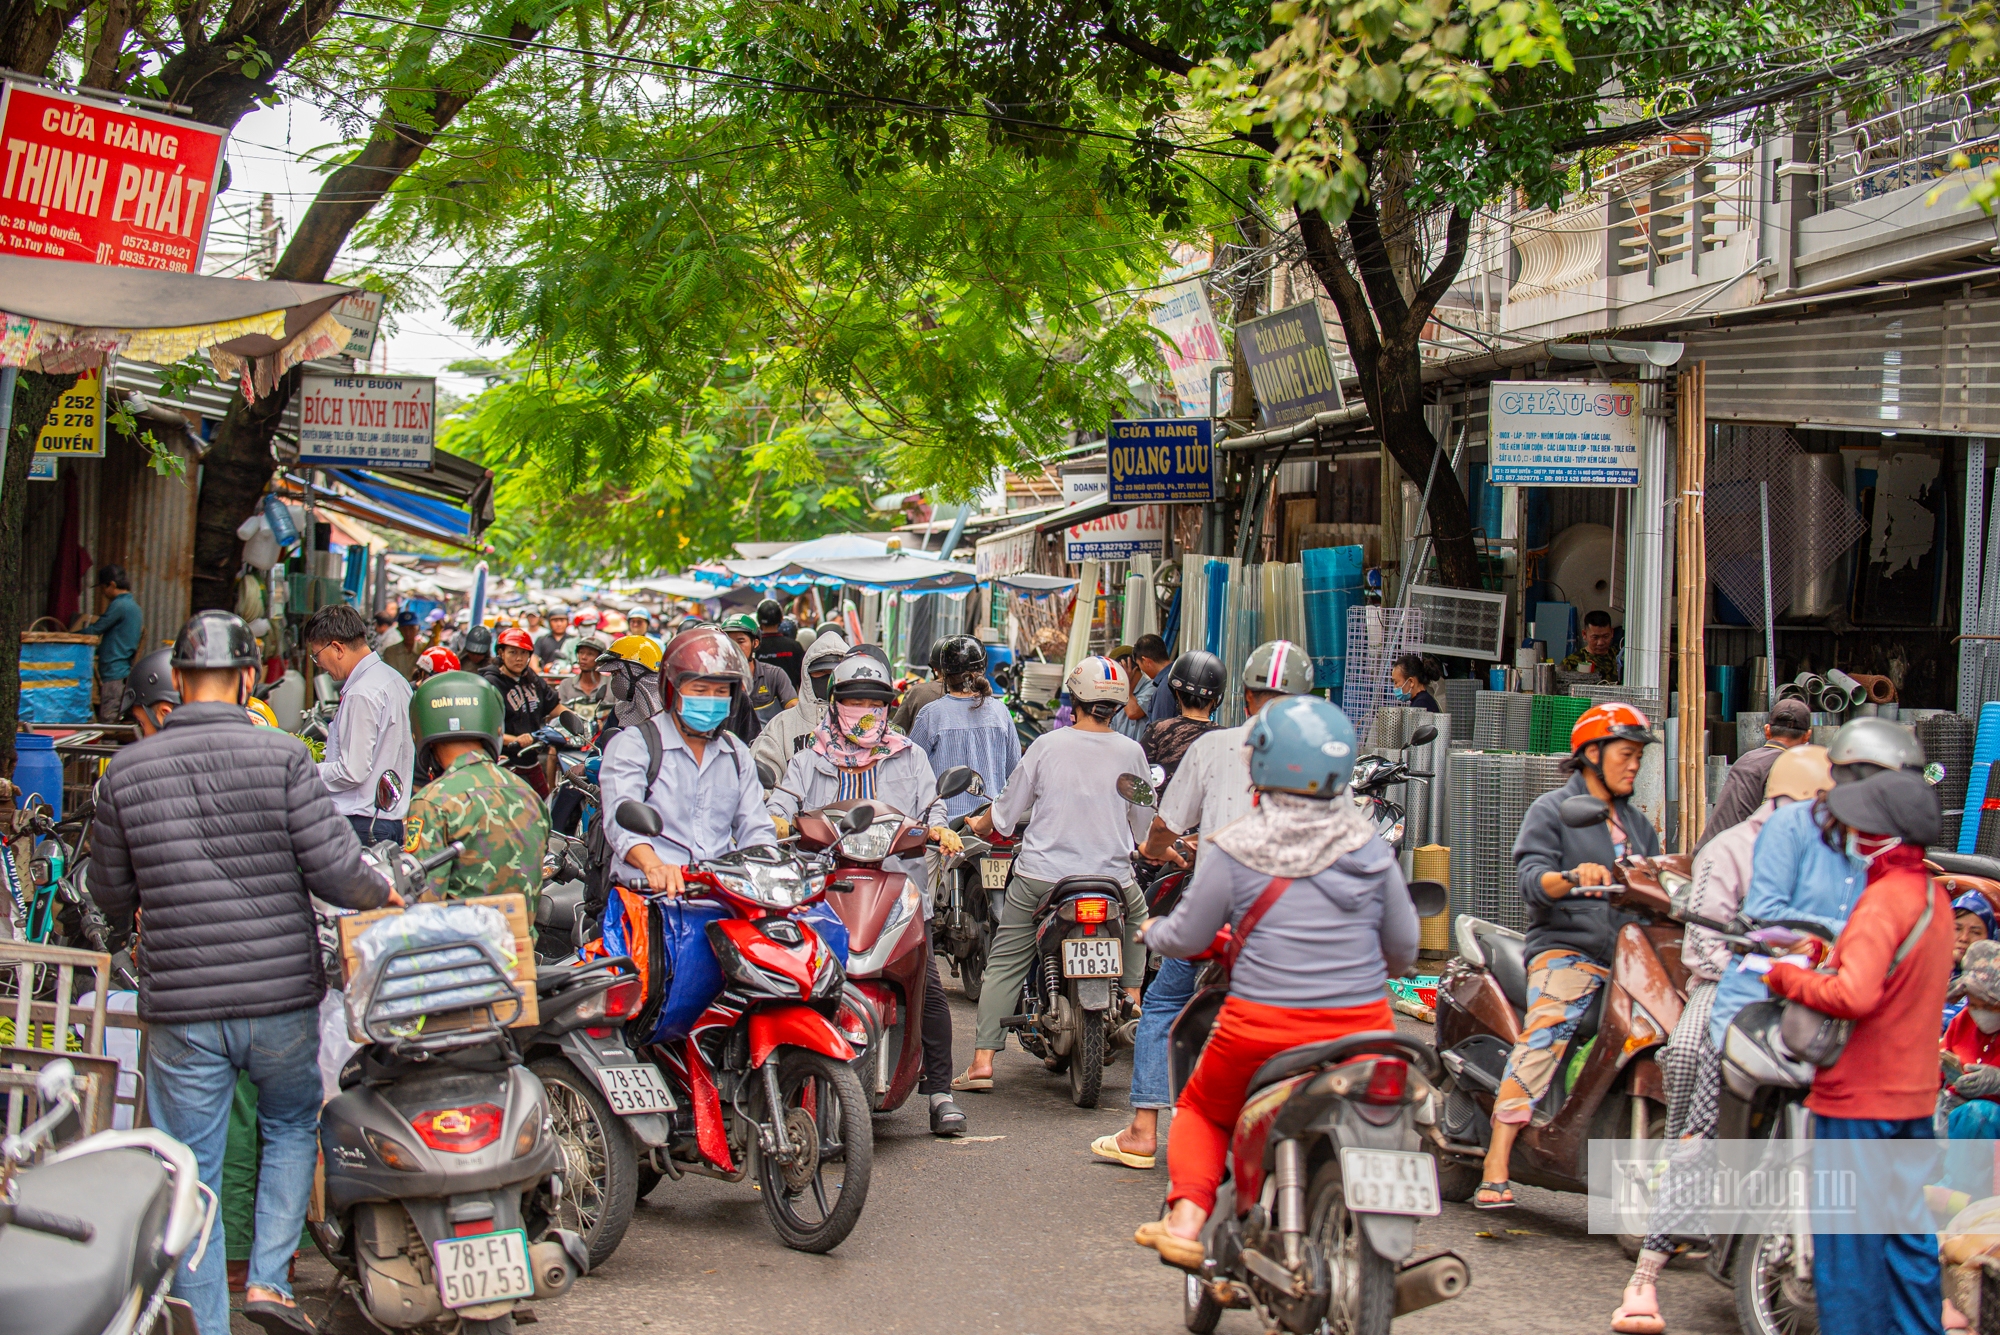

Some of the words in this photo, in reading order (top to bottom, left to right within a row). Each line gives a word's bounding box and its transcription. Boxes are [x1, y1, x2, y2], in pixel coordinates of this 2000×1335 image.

[42, 104, 96, 141] CỬA
[103, 121, 179, 160] HÀNG
[2, 137, 109, 218] THỊNH
[111, 163, 207, 238] PHÁT
[12, 217, 26, 230] 26
[27, 219, 48, 235] Ngô
[49, 222, 83, 243] Quyền,
[44, 239, 66, 257] Hòa
[121, 234, 191, 260] 0573.819421
[119, 250, 188, 273] 0935.773.989
[1255, 322, 1278, 356] CỬA
[1274, 319, 1306, 350] HÀNG
[1252, 354, 1304, 411] QUANG
[64, 396, 95, 409] 252
[303, 388, 343, 425] BÍCH
[348, 391, 387, 427] VĨNH
[393, 388, 431, 430] TIẾN
[64, 414, 94, 428] 278
[1119, 422, 1151, 439] CỬA
[1155, 423, 1198, 438] HÀNG
[43, 433, 94, 451] QUYỀN
[1112, 446, 1171, 482] QUANG
[1074, 483, 1099, 492] DOANH
[1084, 543, 1132, 551] 057.3827922
[431, 696, 454, 709] QUÂN
[455, 696, 471, 706] KHU
[472, 696, 479, 706] 5
[767, 919, 796, 928] HONDA
[1071, 941, 1113, 958] 78-C1
[1067, 957, 1120, 976] 118.34
[723, 990, 748, 1005] HONDA
[606, 1068, 655, 1090] 78-E1
[610, 1088, 671, 1111] 538.78
[1357, 1153, 1420, 1183] 78-K1
[449, 1236, 513, 1272] 78-F1
[445, 1265, 527, 1302] 507.53
